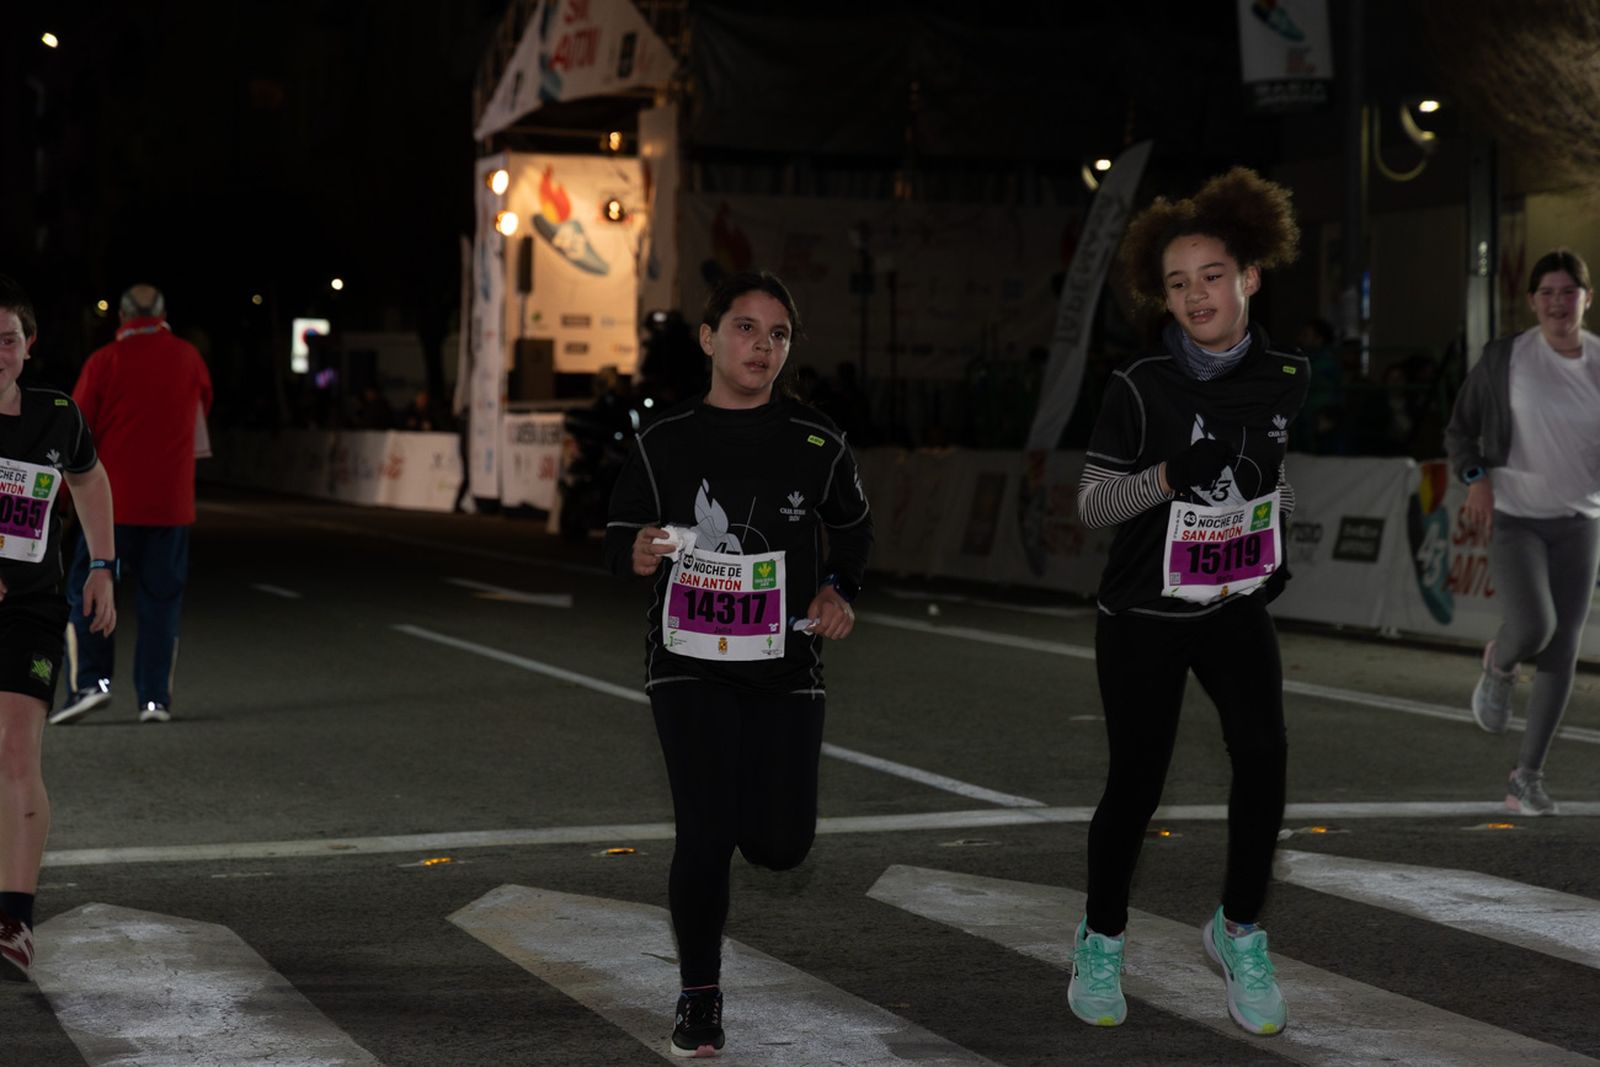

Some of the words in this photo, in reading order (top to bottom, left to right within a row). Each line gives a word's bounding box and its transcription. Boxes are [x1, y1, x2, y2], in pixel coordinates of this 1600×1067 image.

[15, 473, 28, 483] DE
[1198, 518, 1231, 528] NOCHE
[1232, 513, 1245, 525] DE
[1182, 530, 1206, 541] SAN
[1208, 525, 1243, 541] ANTÓN
[1187, 535, 1261, 575] 15119
[693, 562, 725, 577] NOCHE
[728, 567, 742, 578] DE
[680, 573, 700, 586] SAN
[702, 577, 742, 591] ANTÓN
[684, 589, 767, 625] 14317
